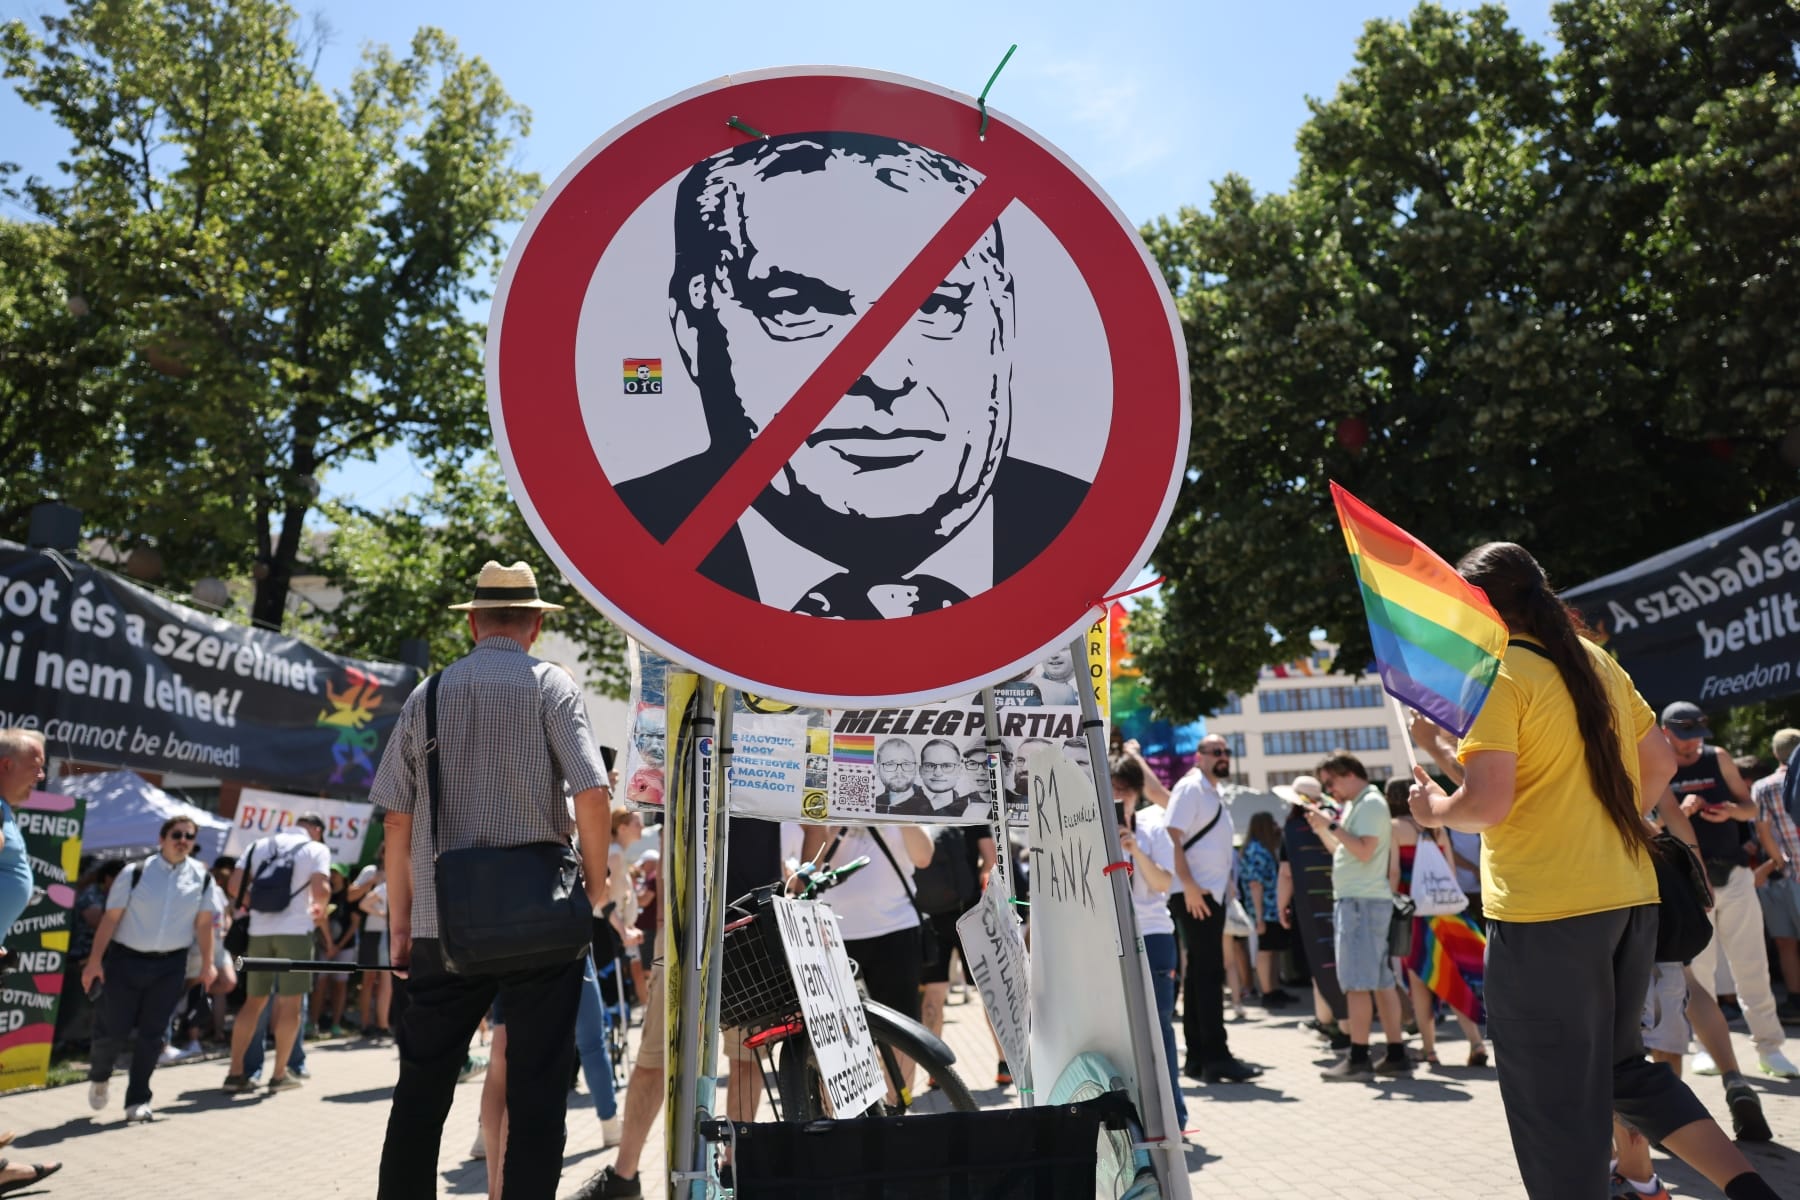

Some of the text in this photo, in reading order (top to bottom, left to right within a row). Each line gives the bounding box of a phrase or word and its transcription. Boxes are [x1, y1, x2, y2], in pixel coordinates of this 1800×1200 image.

[1608, 520, 1800, 634] A szabadsá
[0, 576, 318, 694] ot és a szerelmet
[1696, 592, 1800, 659] betilt
[0, 630, 243, 728] i nem lehet!
[1700, 661, 1791, 700] Freedom
[44, 718, 128, 751] cannot
[130, 725, 161, 754] be
[162, 731, 240, 768] banned!
[743, 745, 775, 755] HOGY
[738, 768, 785, 780] MAGYAR
[11, 812, 80, 837] PENED
[1030, 837, 1095, 912] TANK
[779, 902, 803, 947] Mi
[802, 916, 815, 947] a
[0, 988, 55, 1010] OTTUNK
[853, 1005, 867, 1033] az
